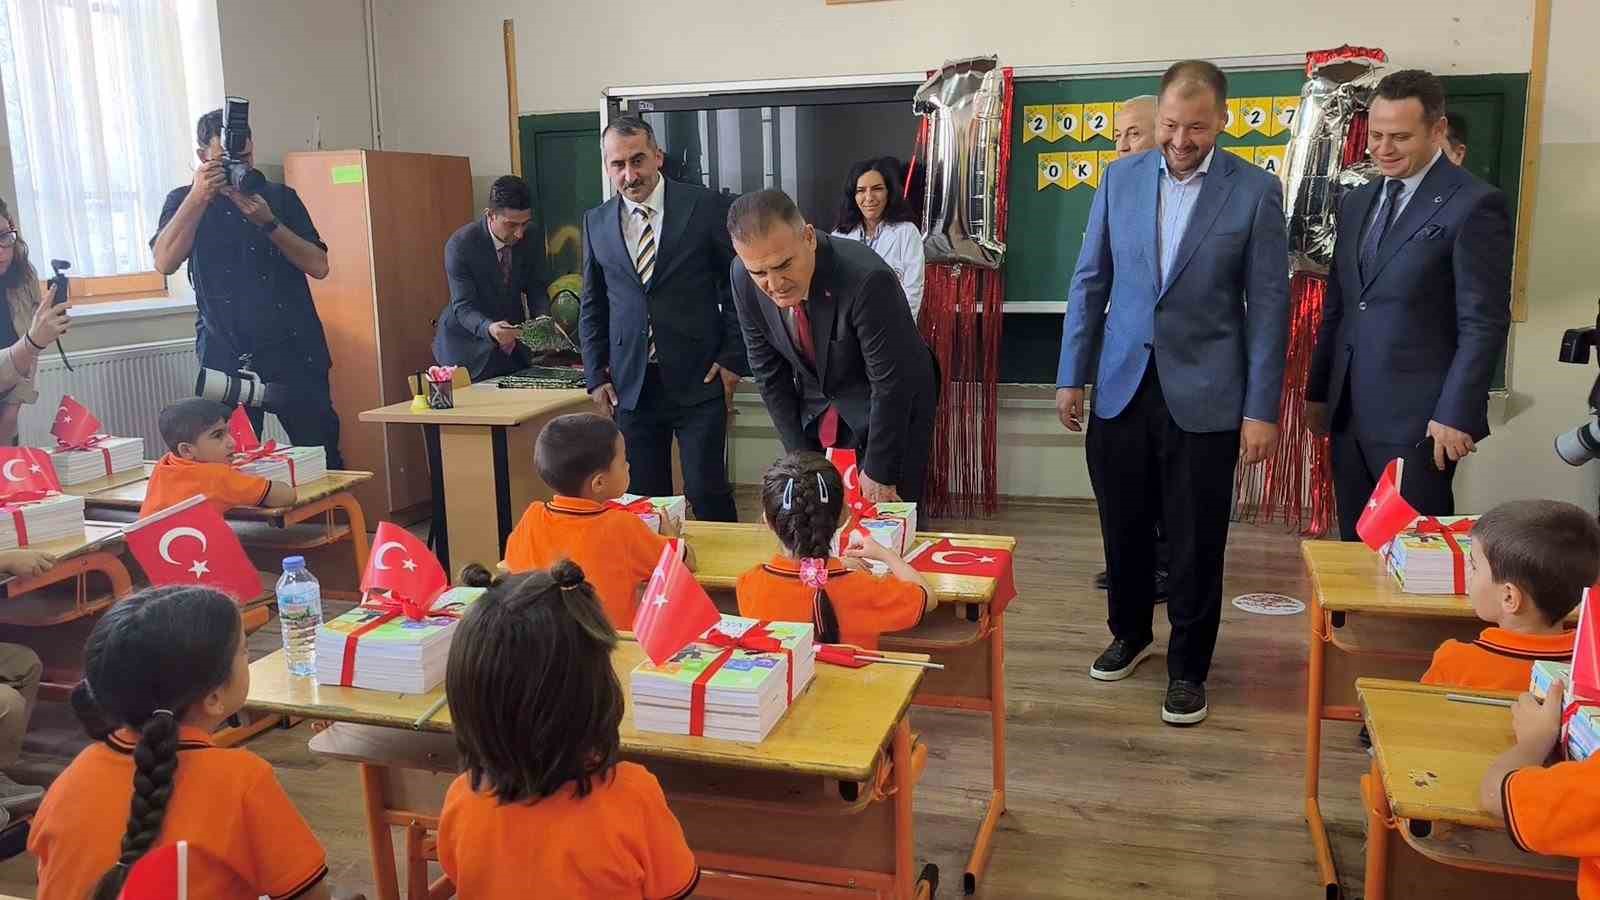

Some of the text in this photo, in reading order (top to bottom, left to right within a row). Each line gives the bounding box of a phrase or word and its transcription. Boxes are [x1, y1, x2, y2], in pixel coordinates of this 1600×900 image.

[1034, 115, 1104, 131] 202
[1225, 109, 1296, 125] 27
[1048, 163, 1088, 178] OK
